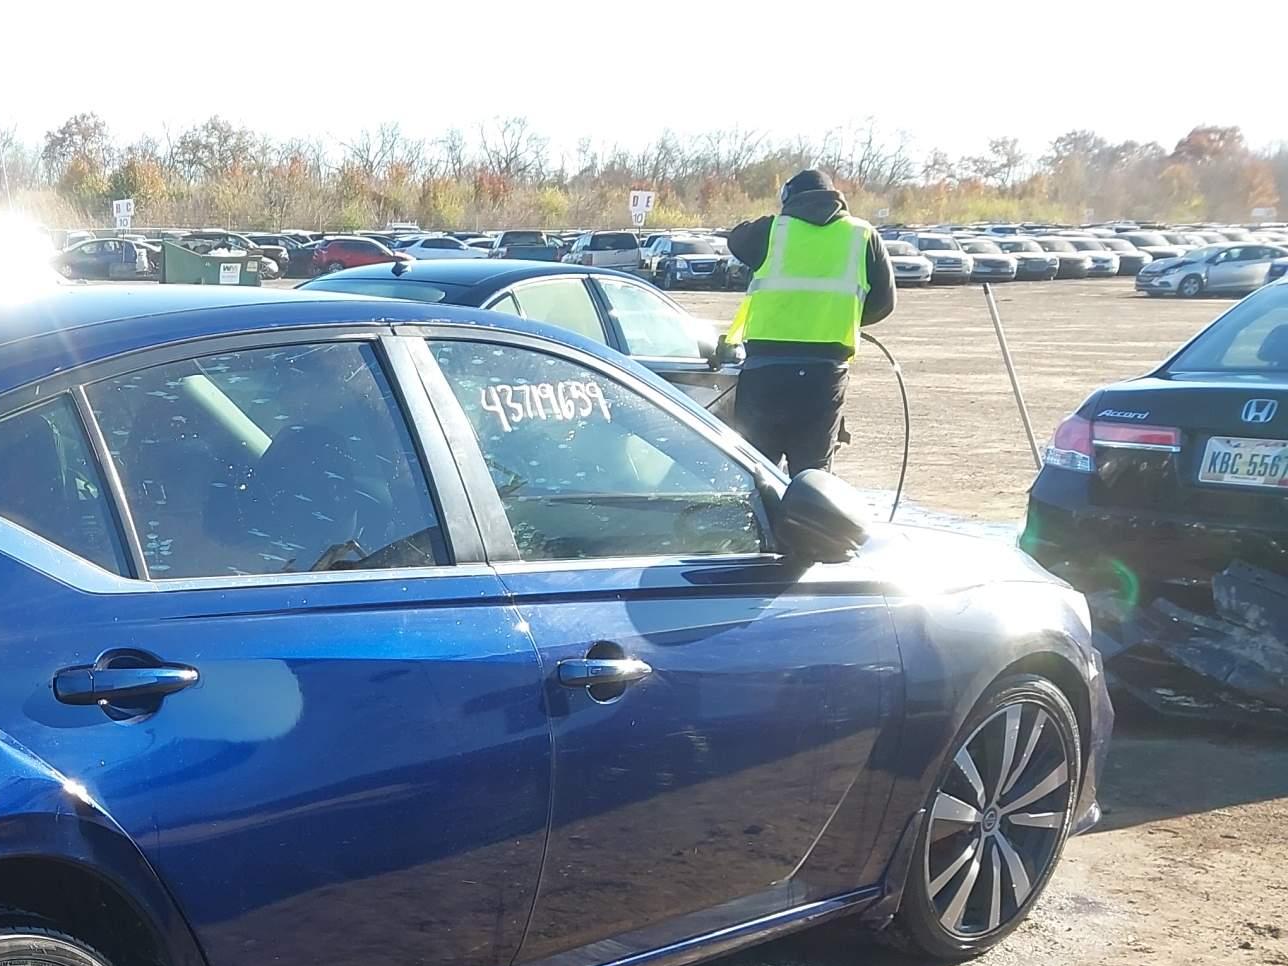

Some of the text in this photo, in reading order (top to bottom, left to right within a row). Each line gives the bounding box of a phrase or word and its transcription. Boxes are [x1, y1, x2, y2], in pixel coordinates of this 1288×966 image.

[632, 213, 644, 224] 10
[481, 381, 611, 432] 43719659
[1097, 409, 1150, 420] Accord
[1208, 451, 1242, 475] KBC
